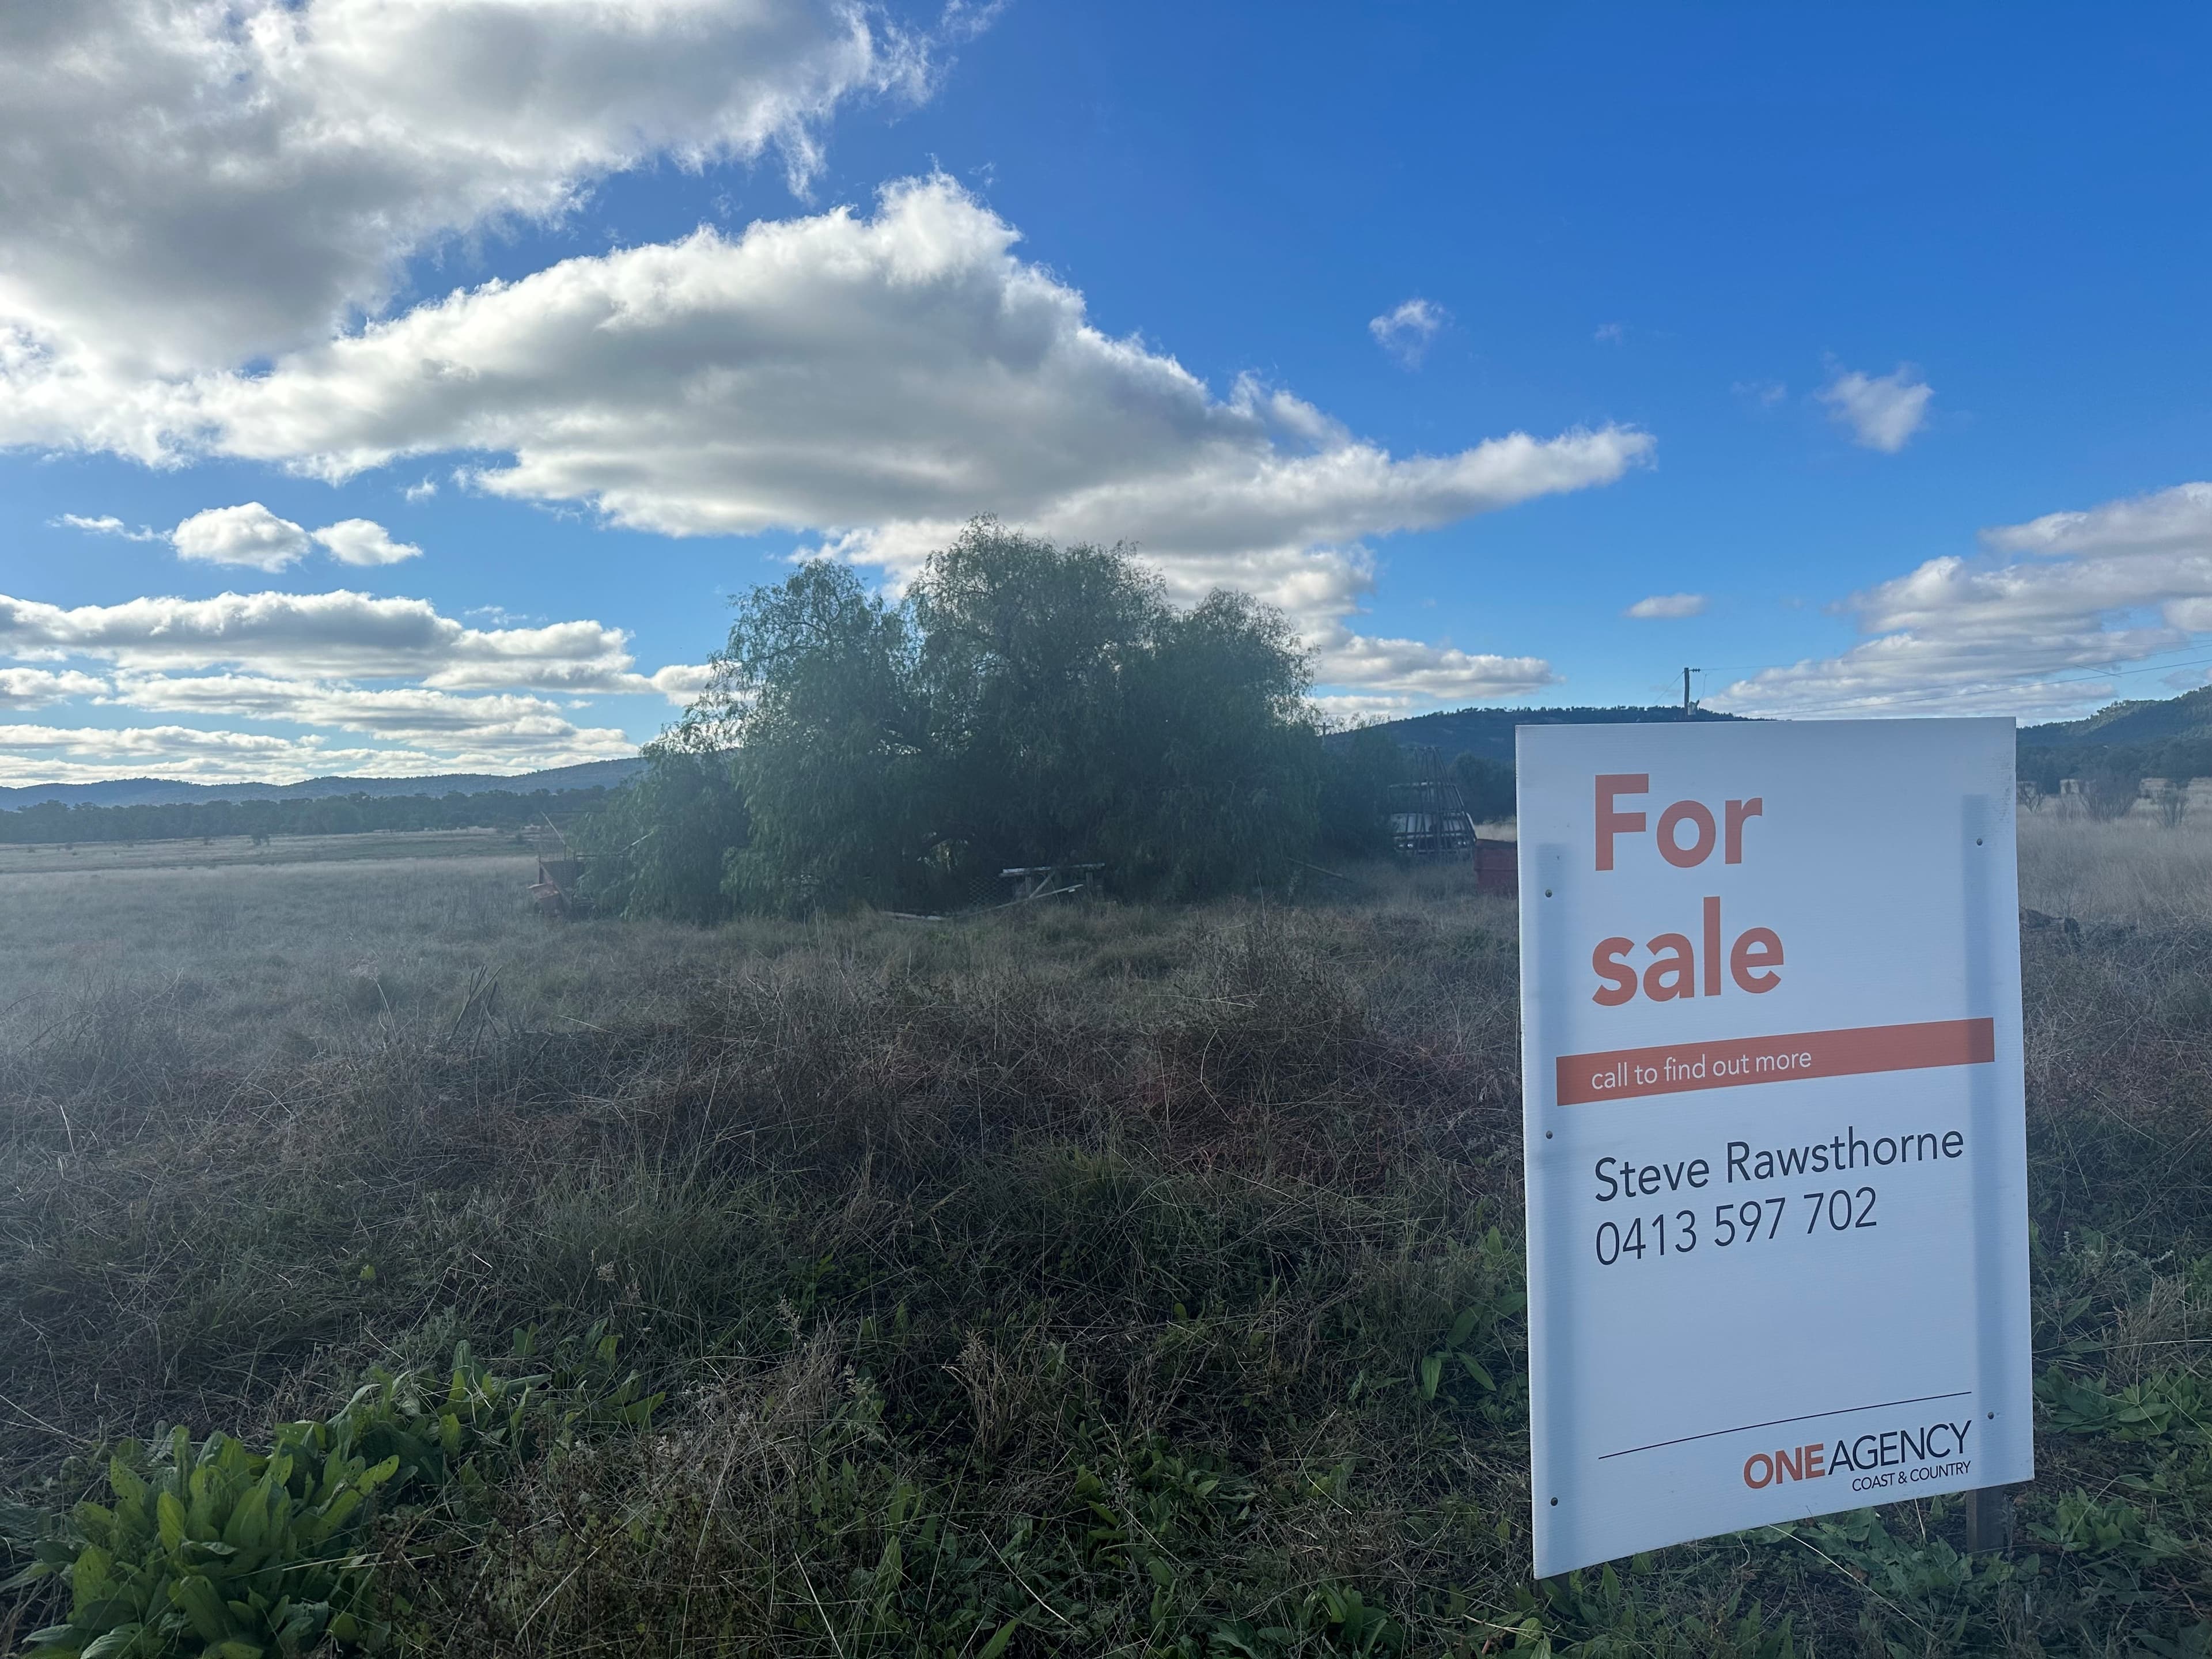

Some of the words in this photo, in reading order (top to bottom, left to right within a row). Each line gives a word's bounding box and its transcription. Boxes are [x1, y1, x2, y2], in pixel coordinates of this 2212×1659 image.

[1594, 772, 1763, 871] For
[1591, 896, 1784, 1007] sale
[1590, 1062, 1628, 1090] call
[1634, 1064, 1658, 1086] to
[1664, 1055, 1707, 1083] find
[1712, 1055, 1749, 1078] out
[1755, 1050, 1812, 1072] more
[1594, 1156, 1710, 1202] Steve
[1726, 1126, 1965, 1184] Rawsthorne
[1596, 1209, 1698, 1266] 0413
[1713, 1196, 1786, 1247] 597
[1803, 1185, 1878, 1234] 702
[1851, 1473, 1895, 1492] COAST
[1897, 1470, 1908, 1485] &
[1908, 1460, 1972, 1483] COUNTRY
